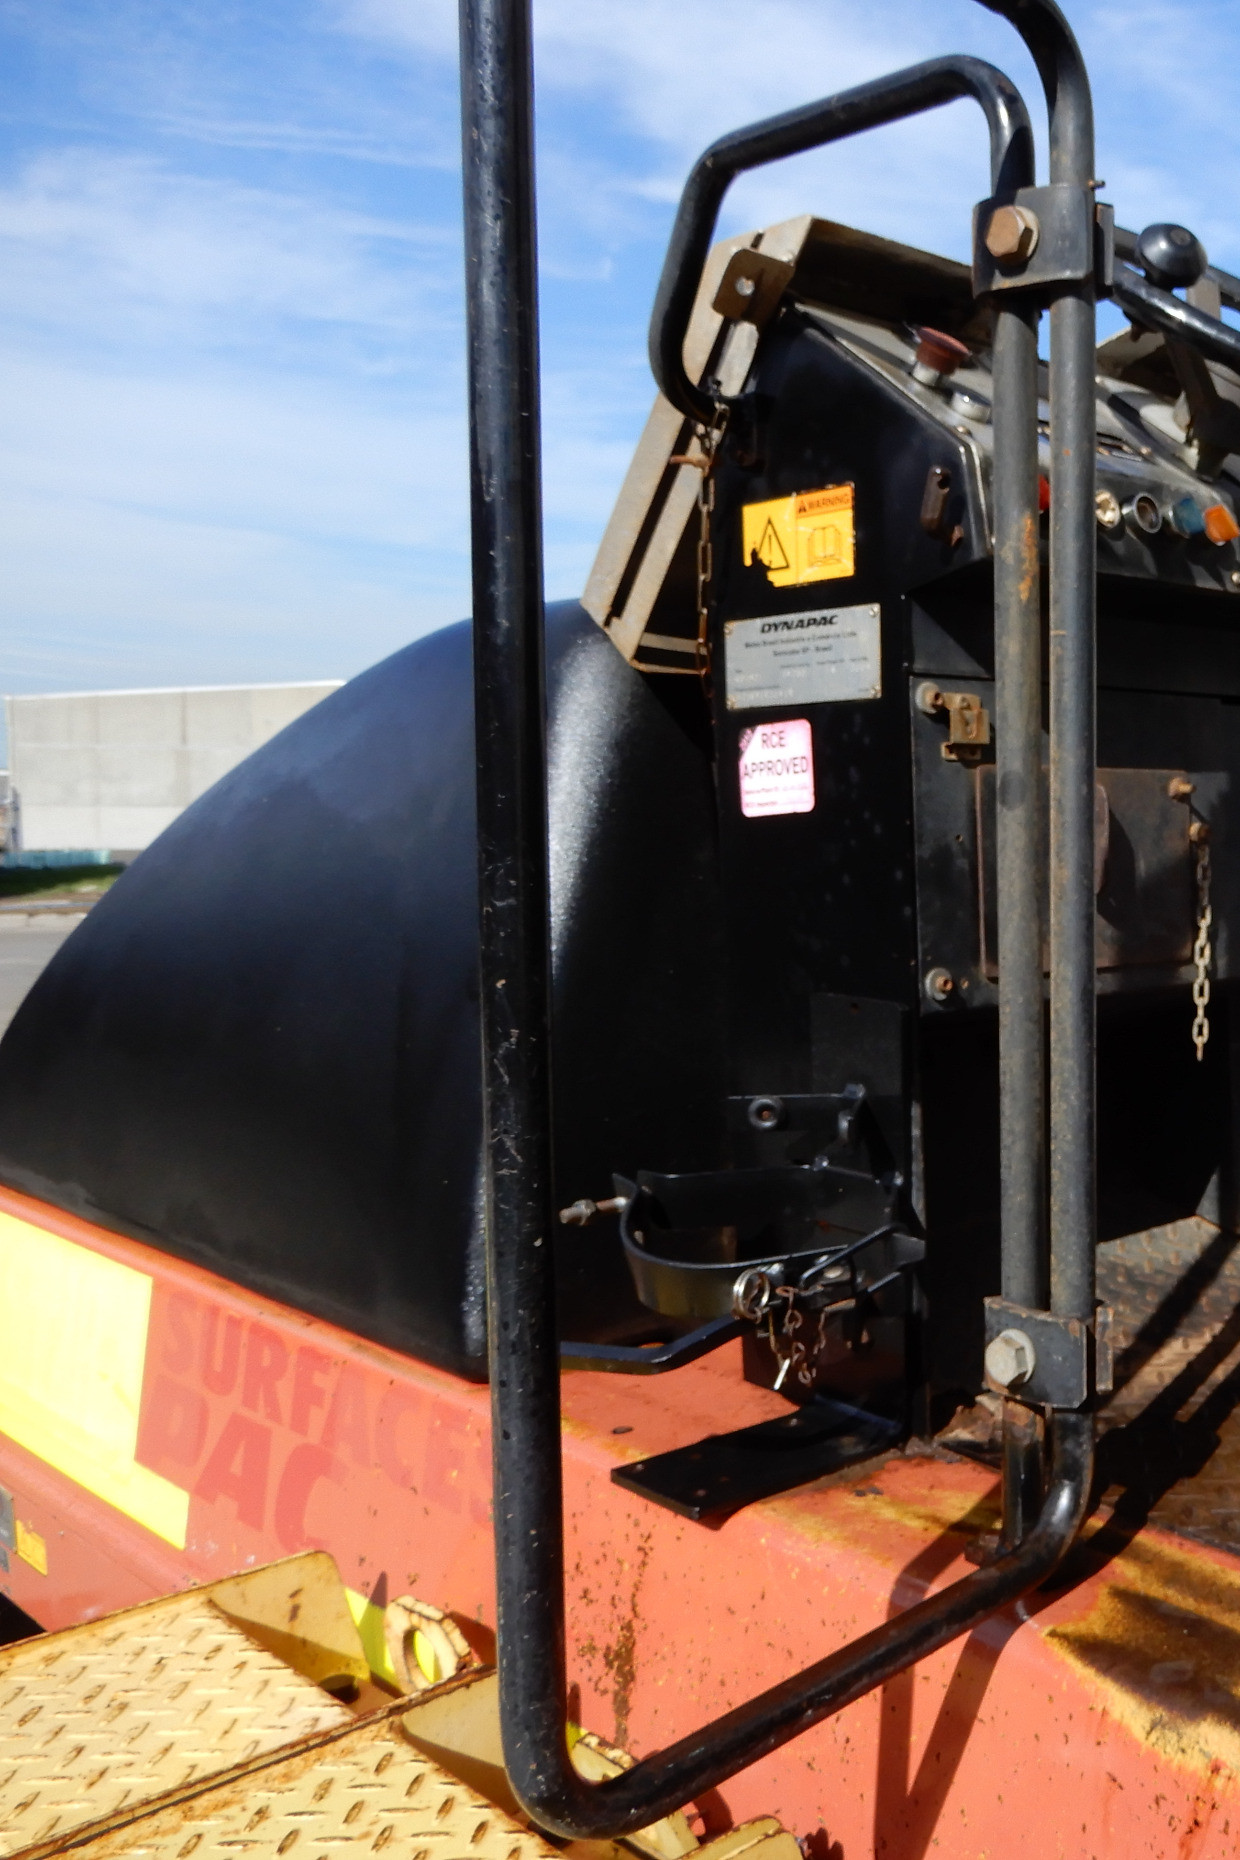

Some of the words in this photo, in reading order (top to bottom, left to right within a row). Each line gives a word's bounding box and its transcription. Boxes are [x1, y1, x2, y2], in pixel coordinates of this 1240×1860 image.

[760, 614, 840, 634] DYNAPAC
[761, 730, 786, 749] RCE
[743, 755, 809, 779] APPROVED
